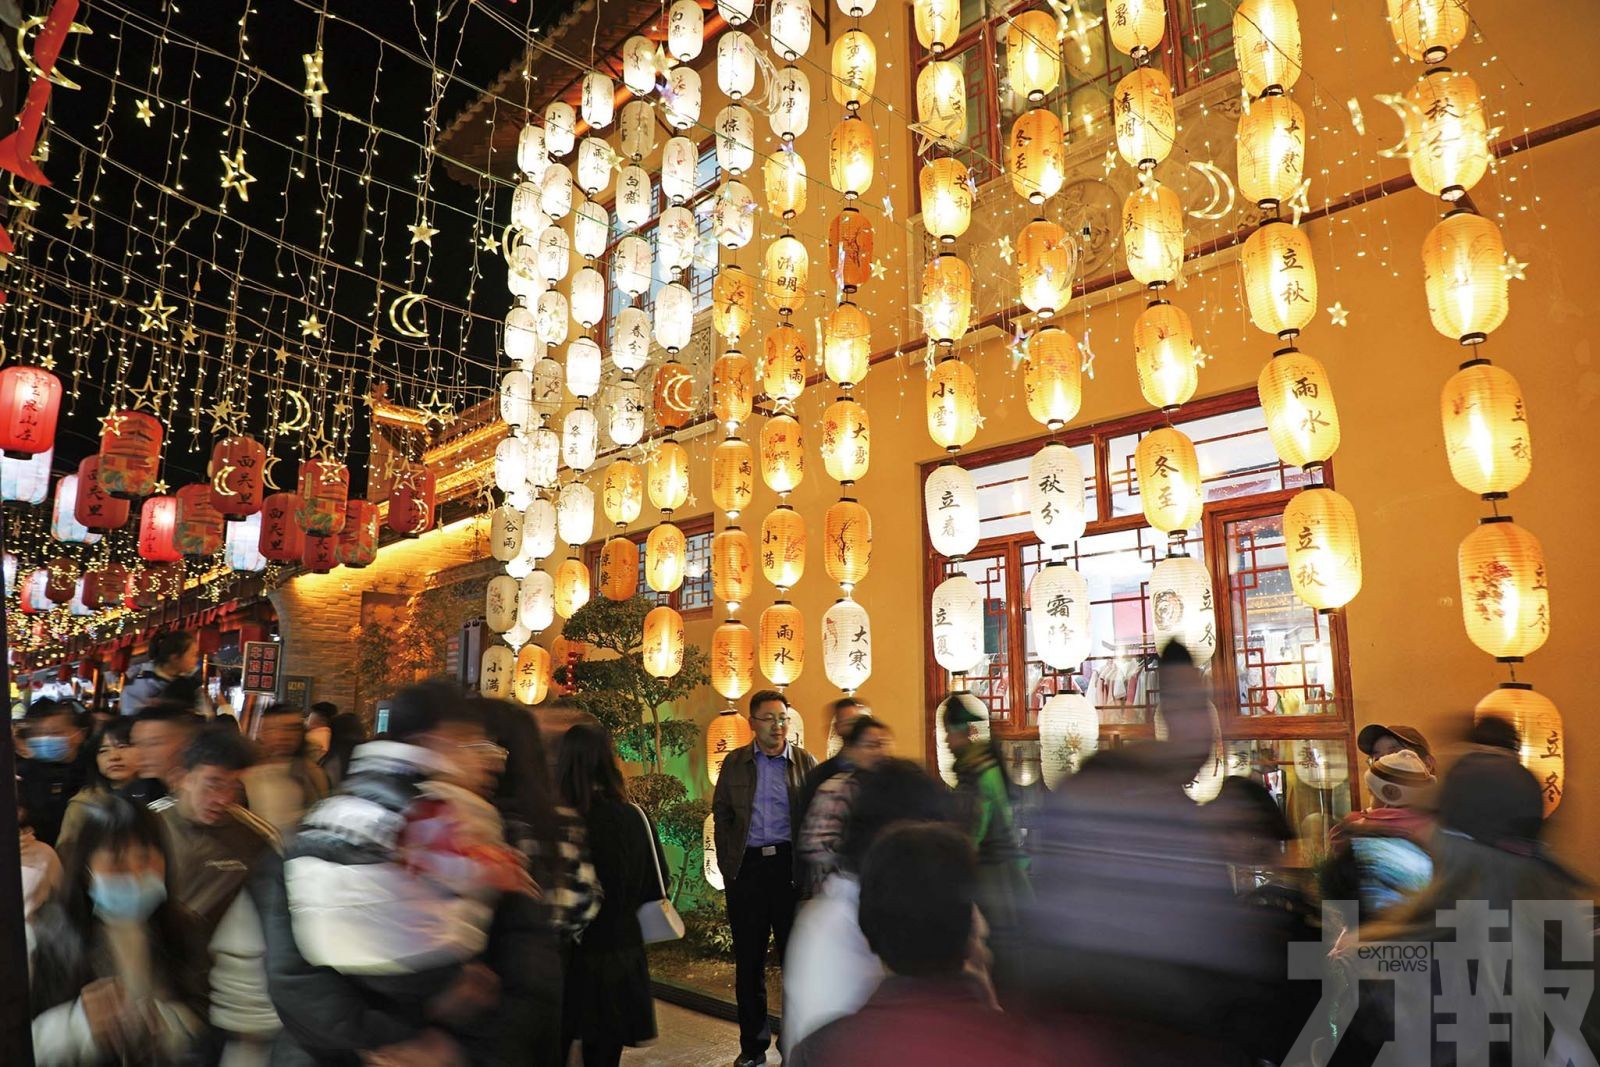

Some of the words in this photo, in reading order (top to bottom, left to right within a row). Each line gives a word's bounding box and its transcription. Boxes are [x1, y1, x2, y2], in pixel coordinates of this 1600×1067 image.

[1115, 92, 1136, 139] 清明
[1014, 129, 1032, 171] 冬至
[777, 256, 798, 292] 清明
[1280, 248, 1310, 305] 立秋
[628, 324, 645, 355] 春分
[788, 346, 806, 384] 谷雨
[1292, 377, 1330, 434] 雨水
[851, 422, 868, 465] 大雪
[738, 461, 752, 497] 雨水
[1039, 474, 1065, 526] 秋分
[1150, 455, 1179, 510] 冬至
[503, 520, 519, 550] 谷雨
[938, 490, 960, 537] 立春
[1295, 526, 1327, 588] 立秋
[934, 608, 954, 657] 立夏
[1046, 594, 1075, 646] 霜降
[1199, 587, 1217, 646] 立冬
[773, 624, 795, 666] 雨水
[848, 625, 869, 672] 大寒
[486, 661, 503, 693] 小满
[519, 662, 536, 689] 芒种
[1540, 731, 1562, 803] 立冬
